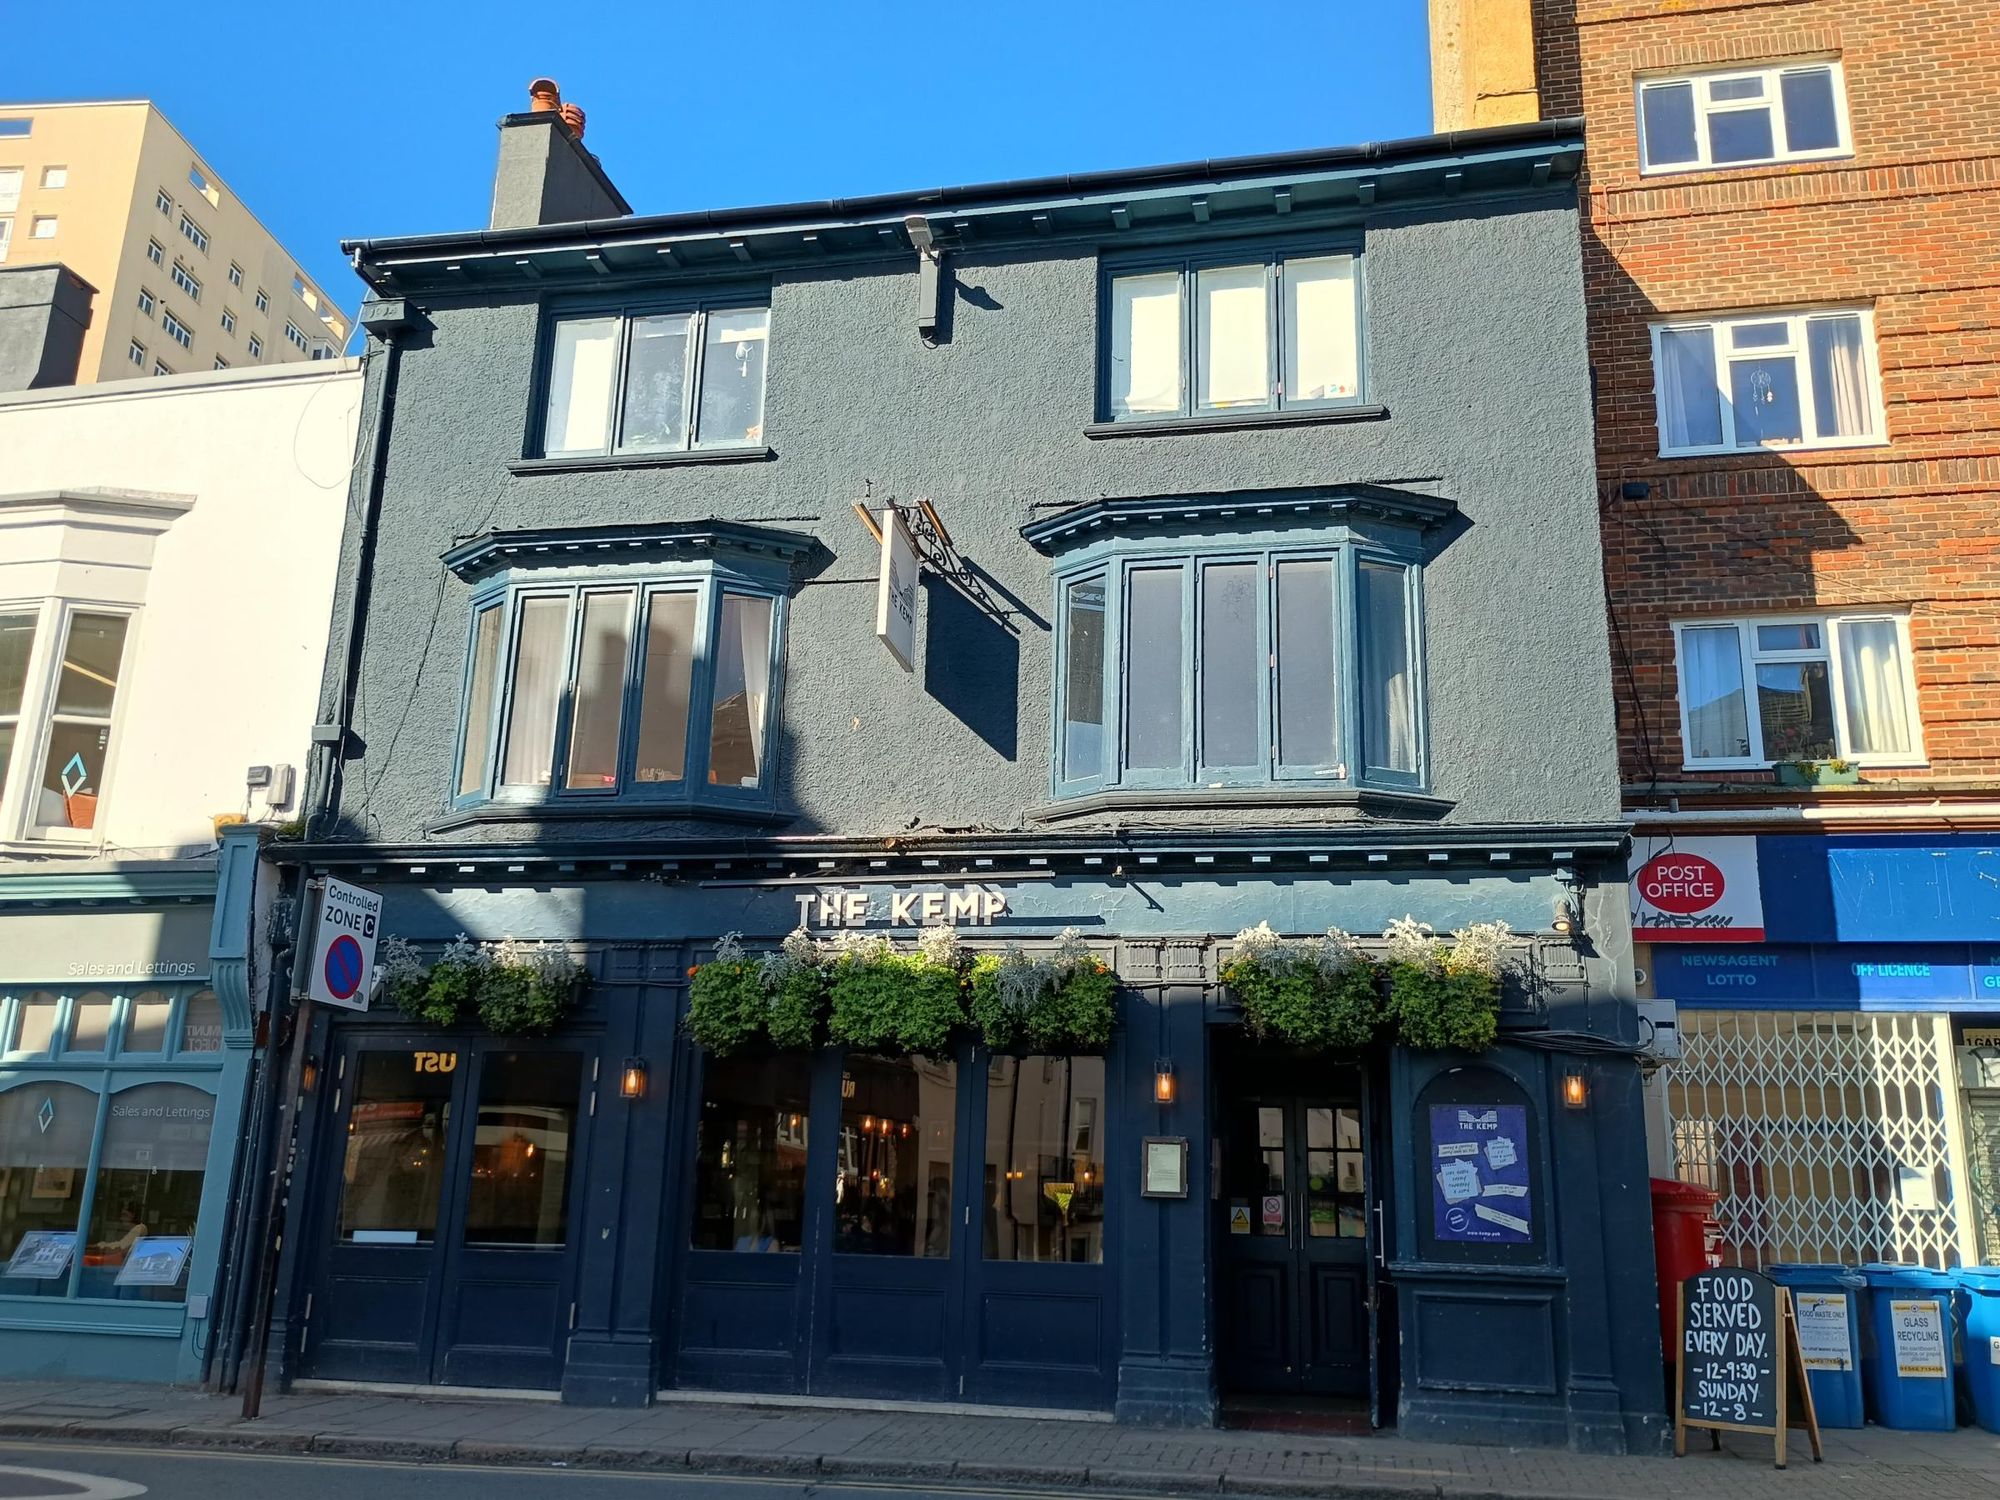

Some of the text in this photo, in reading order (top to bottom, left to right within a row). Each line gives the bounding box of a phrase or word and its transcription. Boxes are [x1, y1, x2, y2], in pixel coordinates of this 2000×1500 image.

[1657, 866, 1705, 881] POST
[1646, 882, 1715, 898] OFFICE
[329, 885, 379, 912] Controlled
[795, 891, 1007, 927] THE KEMP
[325, 905, 362, 931] ZONE
[68, 960, 196, 977] Sales and Lettings
[1682, 955, 1778, 967] NEWSAGENT
[1851, 962, 1931, 977] OFF LICENCE
[1707, 975, 1757, 986] LOTTO
[112, 1106, 211, 1119] Sales and Lettings
[1459, 1122, 1498, 1130] THE KEMP
[1696, 1277, 1754, 1302] FOOD
[1690, 1302, 1762, 1329] SERVED
[1903, 1317, 1929, 1328] GLASS
[1685, 1330, 1768, 1358] EVERY DAY.
[1897, 1331, 1939, 1341] RECYCLING
[1698, 1380, 1759, 1403] SUNDAY
